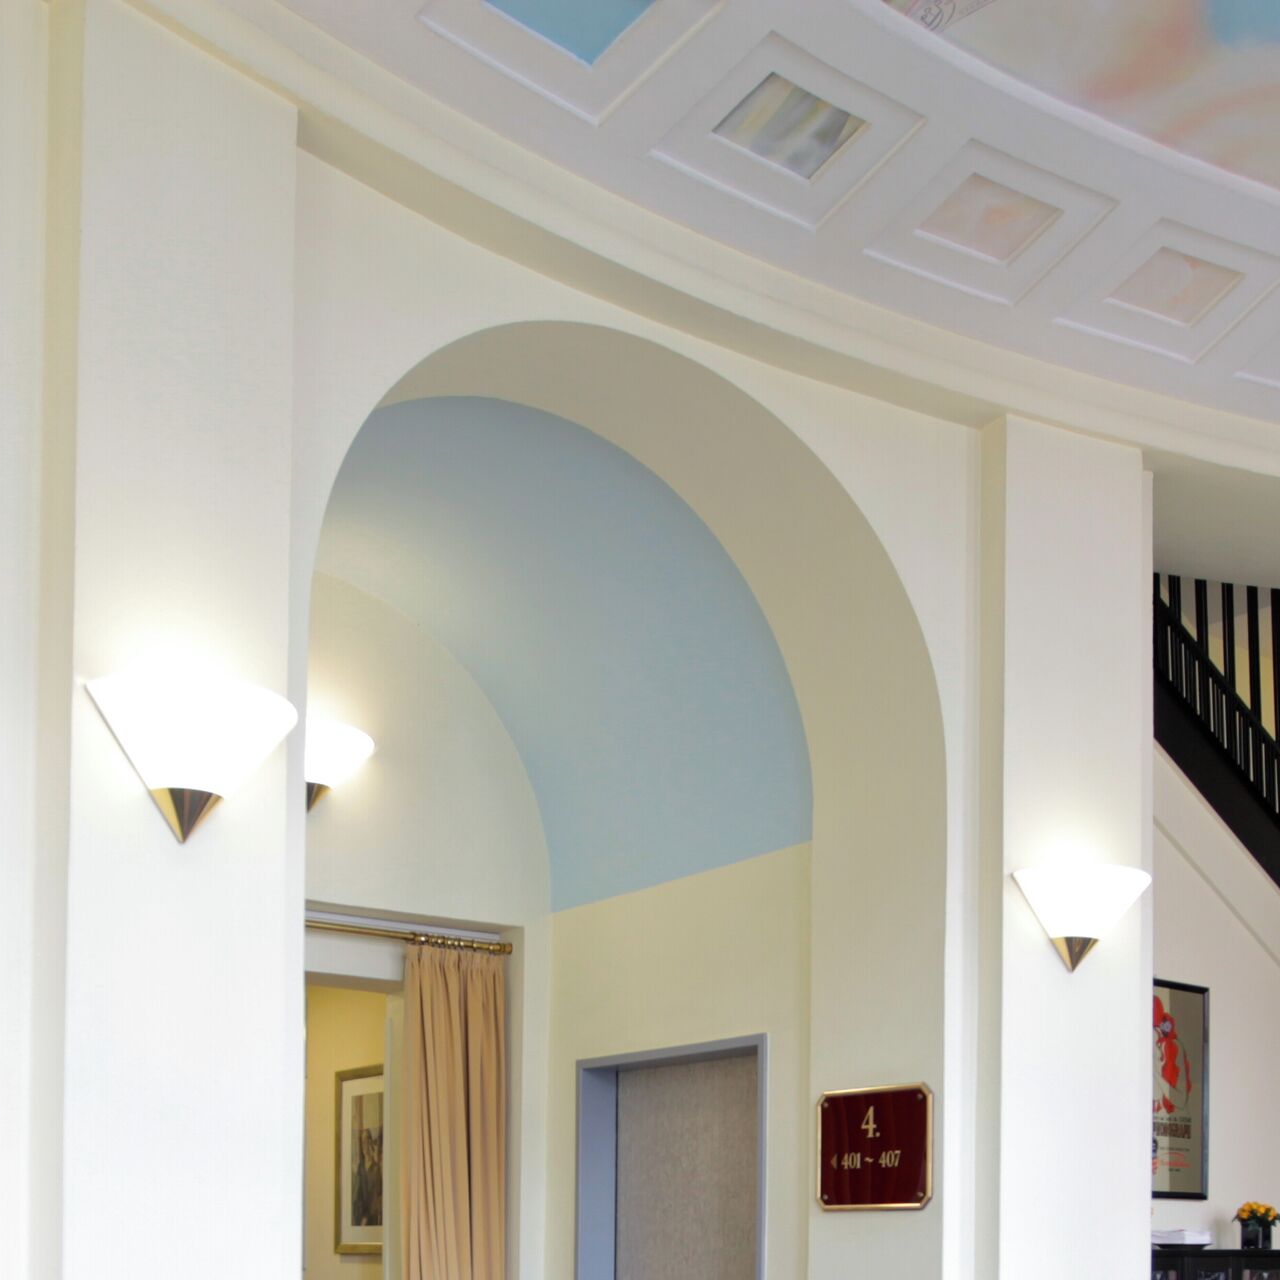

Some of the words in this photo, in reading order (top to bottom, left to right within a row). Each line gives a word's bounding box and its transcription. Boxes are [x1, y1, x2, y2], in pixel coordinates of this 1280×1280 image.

[860, 1105, 880, 1138] 4.
[841, 1152, 862, 1170] 401
[878, 1150, 901, 1168] 407
